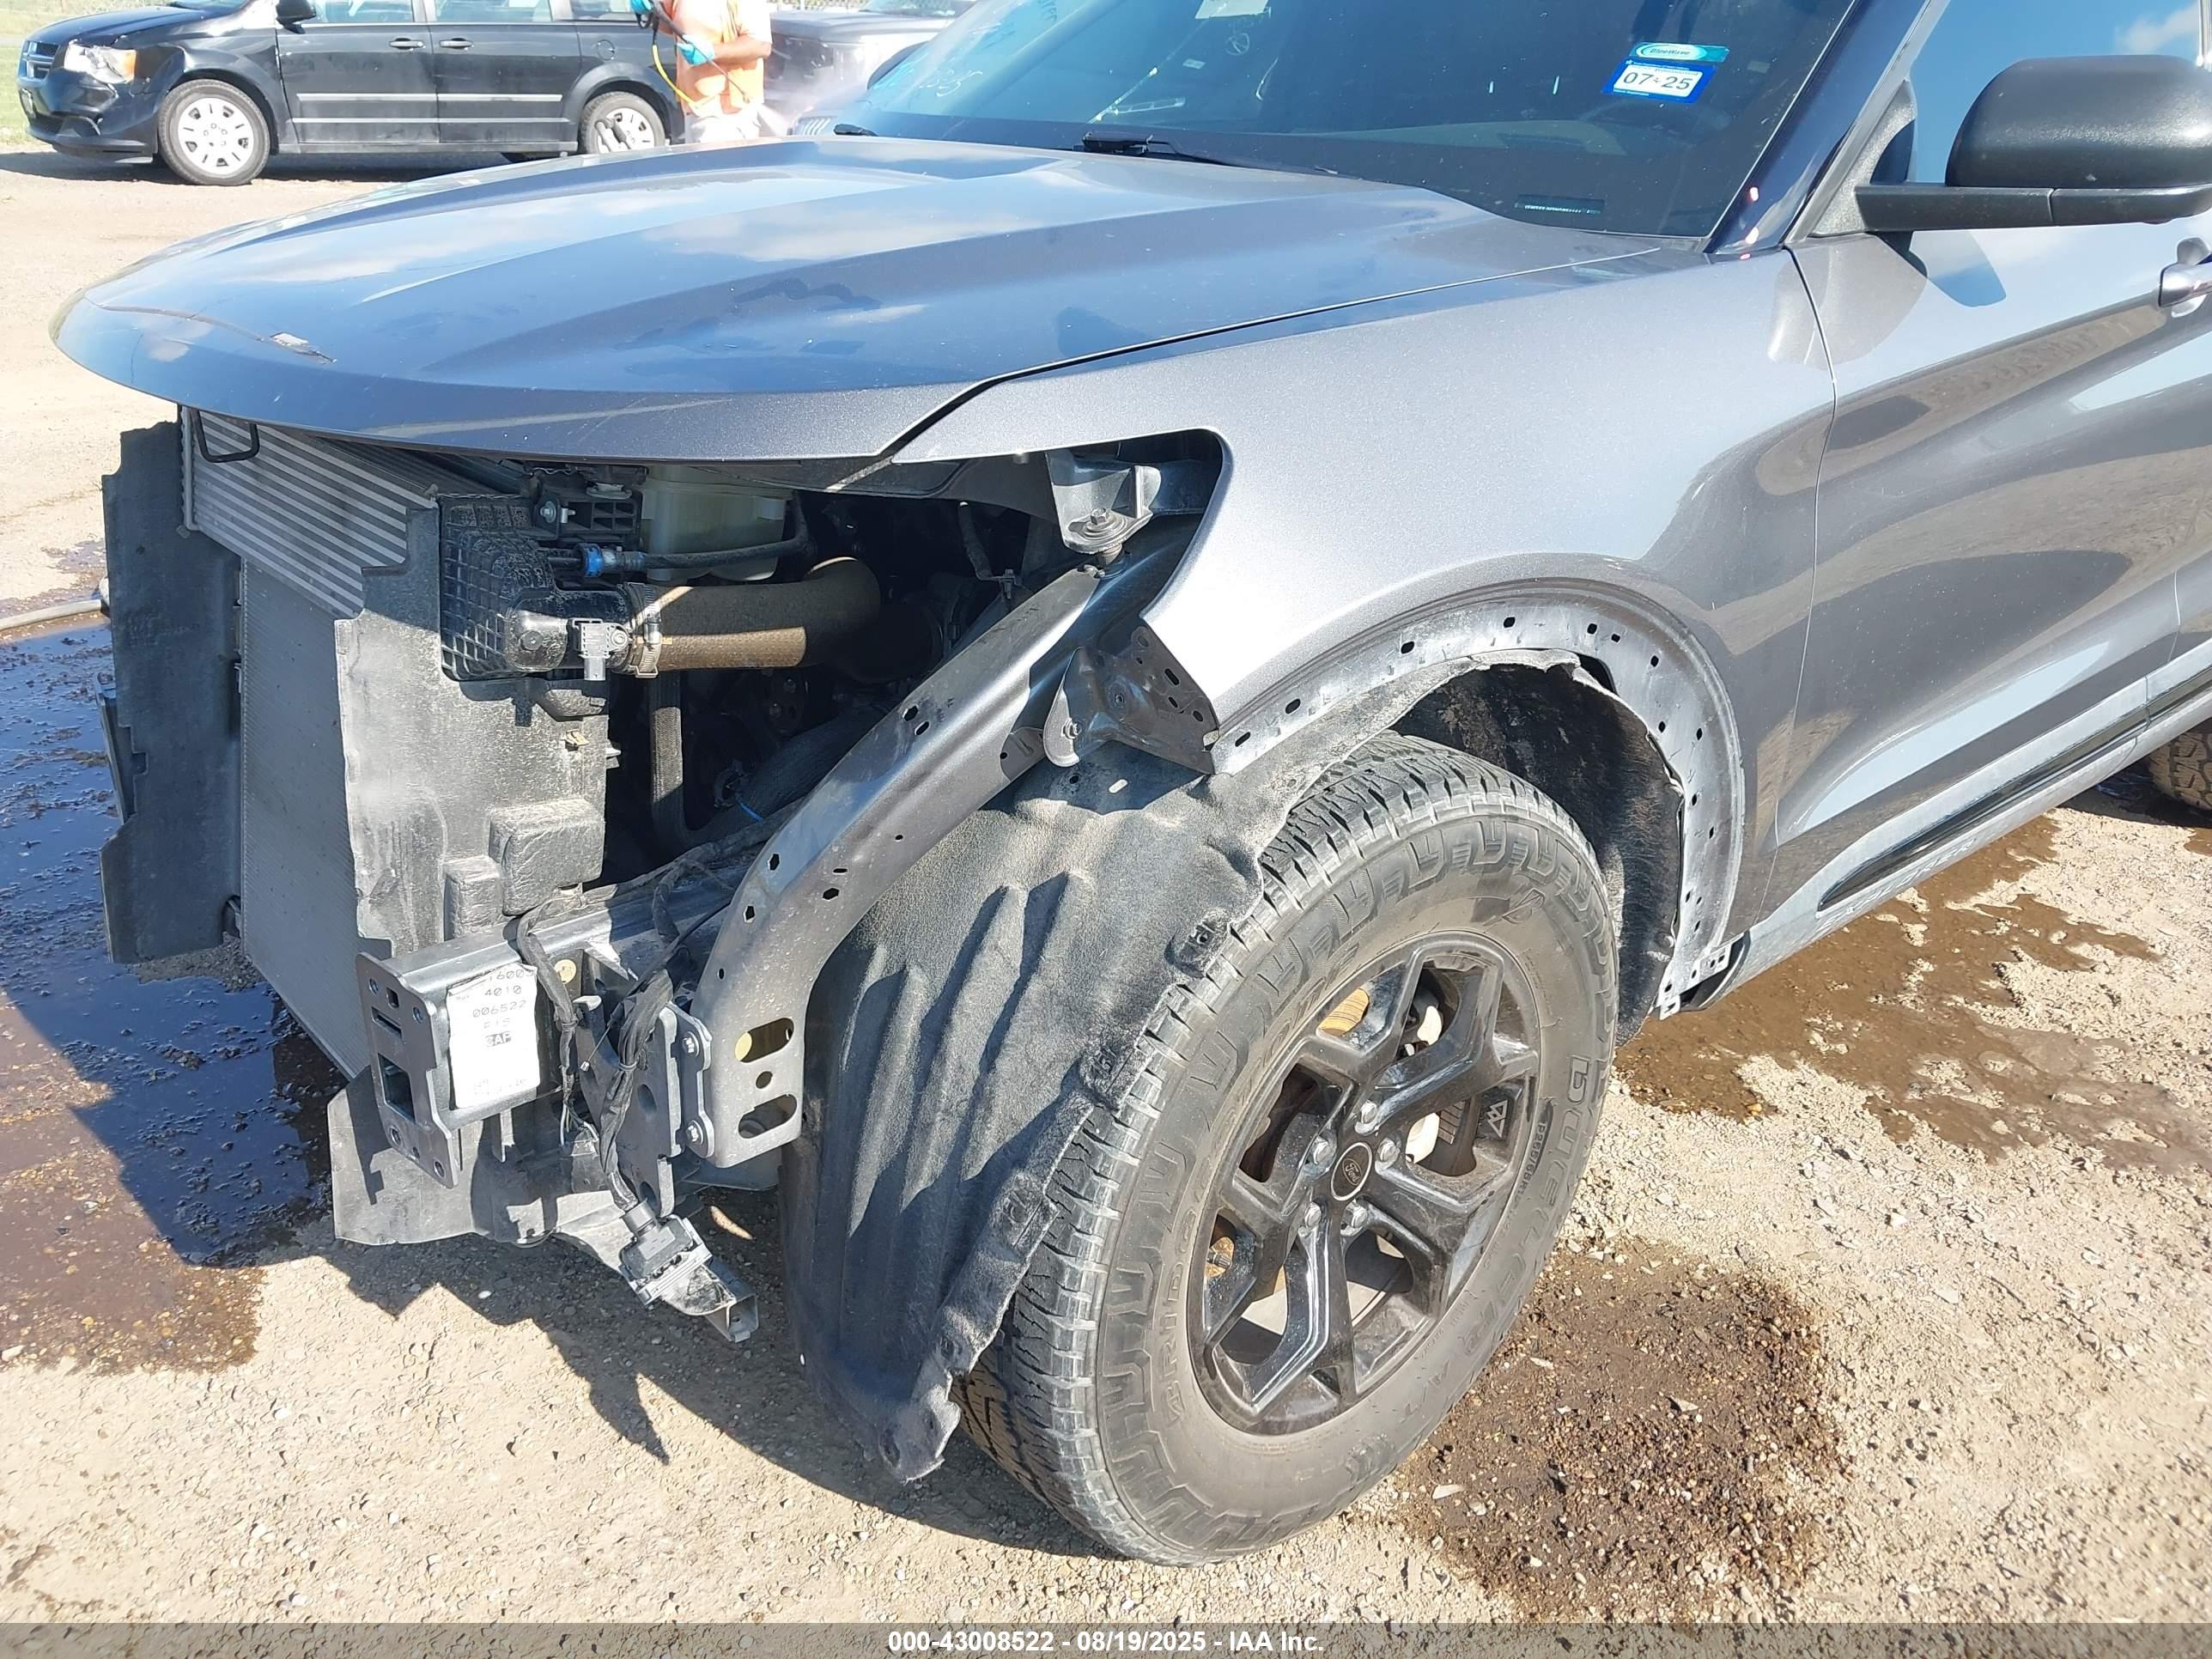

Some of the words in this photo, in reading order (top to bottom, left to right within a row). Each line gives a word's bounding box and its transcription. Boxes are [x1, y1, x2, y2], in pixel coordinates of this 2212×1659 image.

[1623, 71, 1654, 85] 07
[1661, 76, 1693, 90] 25
[484, 985, 521, 996] 4010
[472, 1000, 526, 1018] 006522
[1345, 1162, 1361, 1183] Ford
